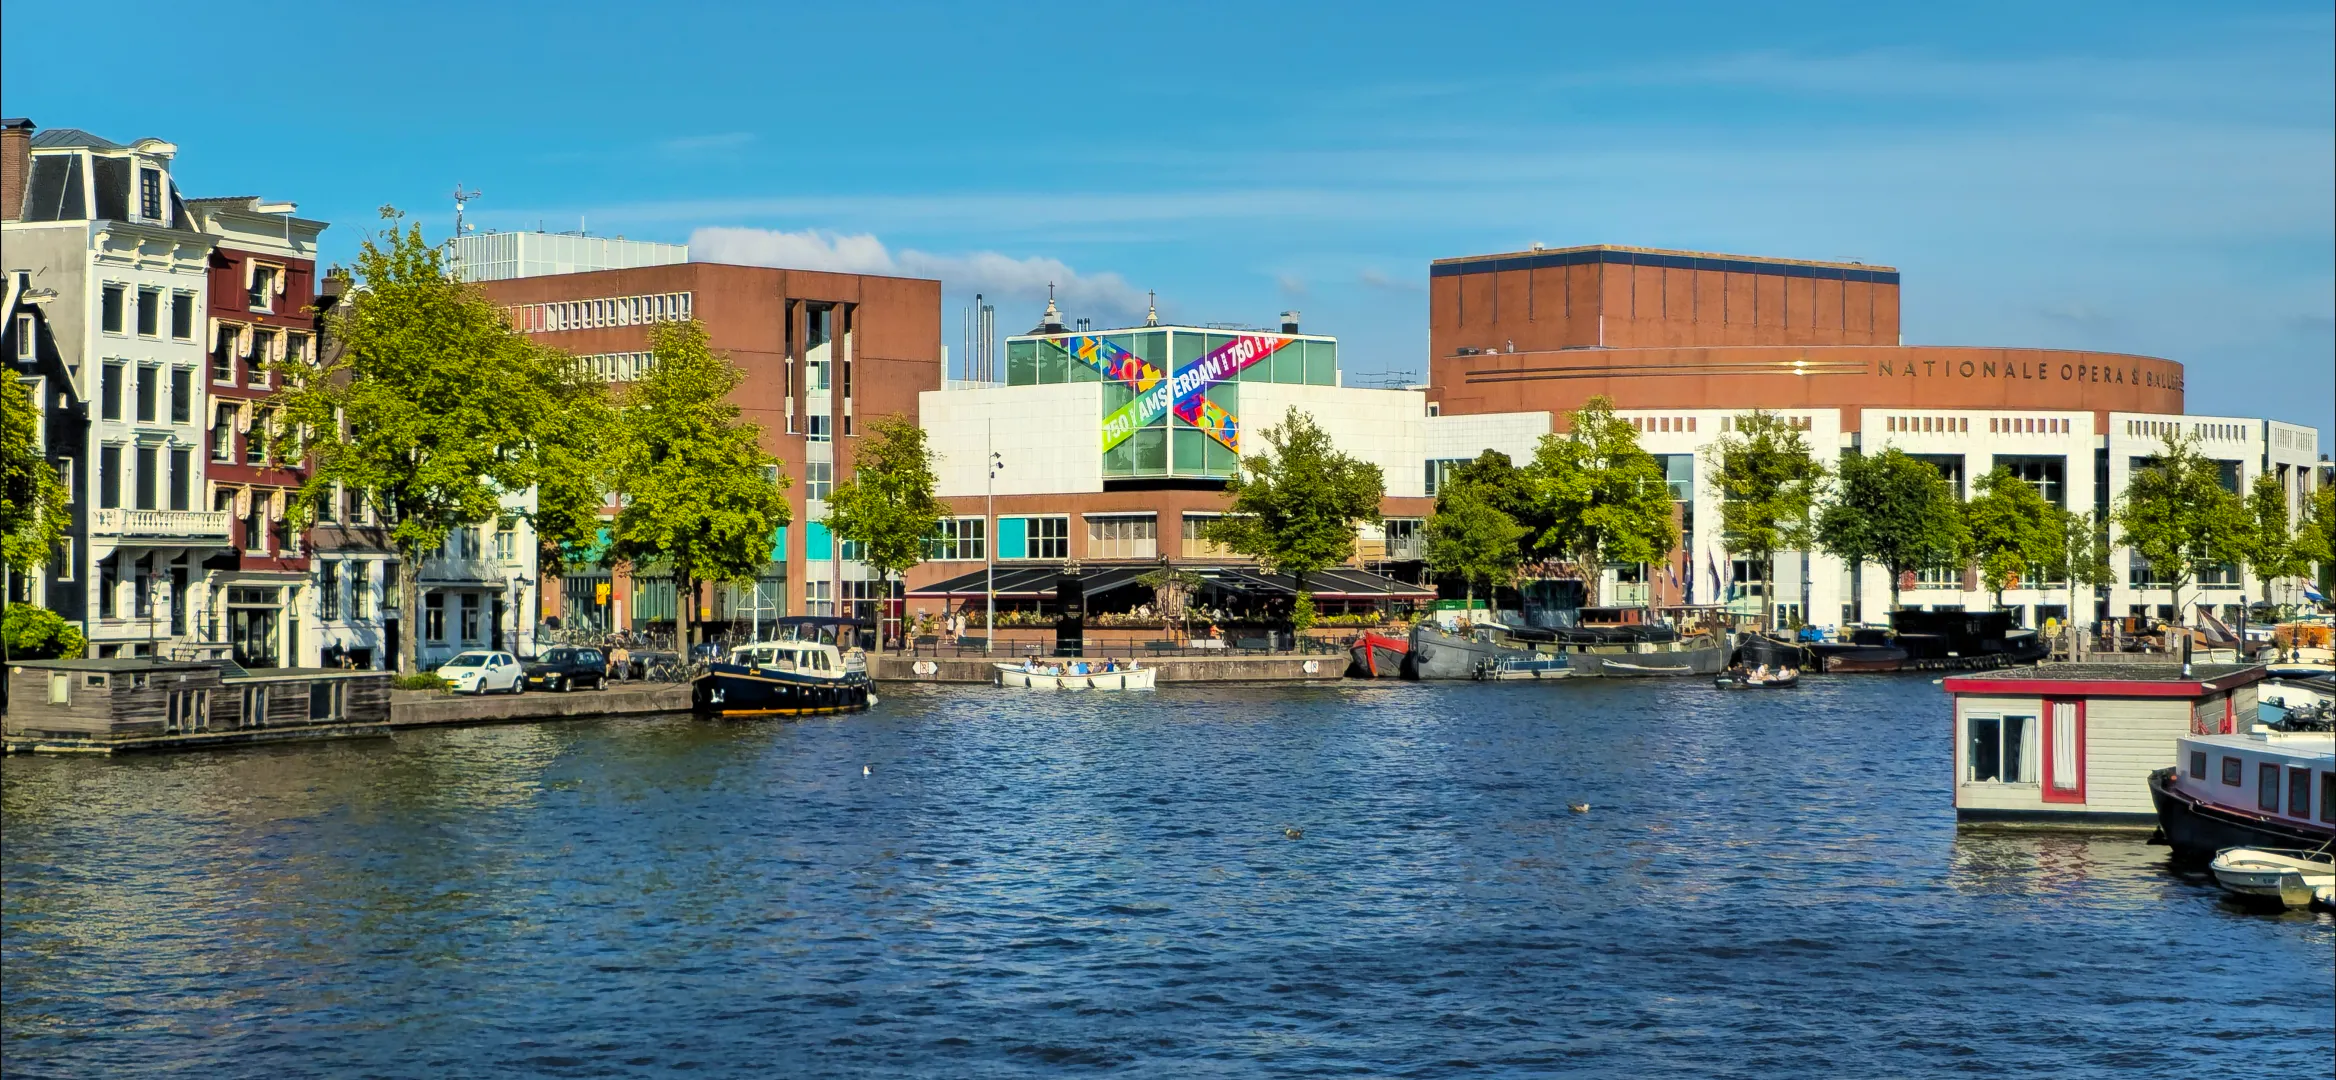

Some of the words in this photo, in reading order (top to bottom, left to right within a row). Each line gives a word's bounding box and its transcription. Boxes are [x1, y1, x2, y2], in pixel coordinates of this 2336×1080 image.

[1103, 414, 1128, 443] 750
[1227, 341, 1254, 367] 750
[1878, 359, 2048, 380] NATIONALE
[2060, 363, 2123, 384] OPERA
[2131, 367, 2139, 386] &
